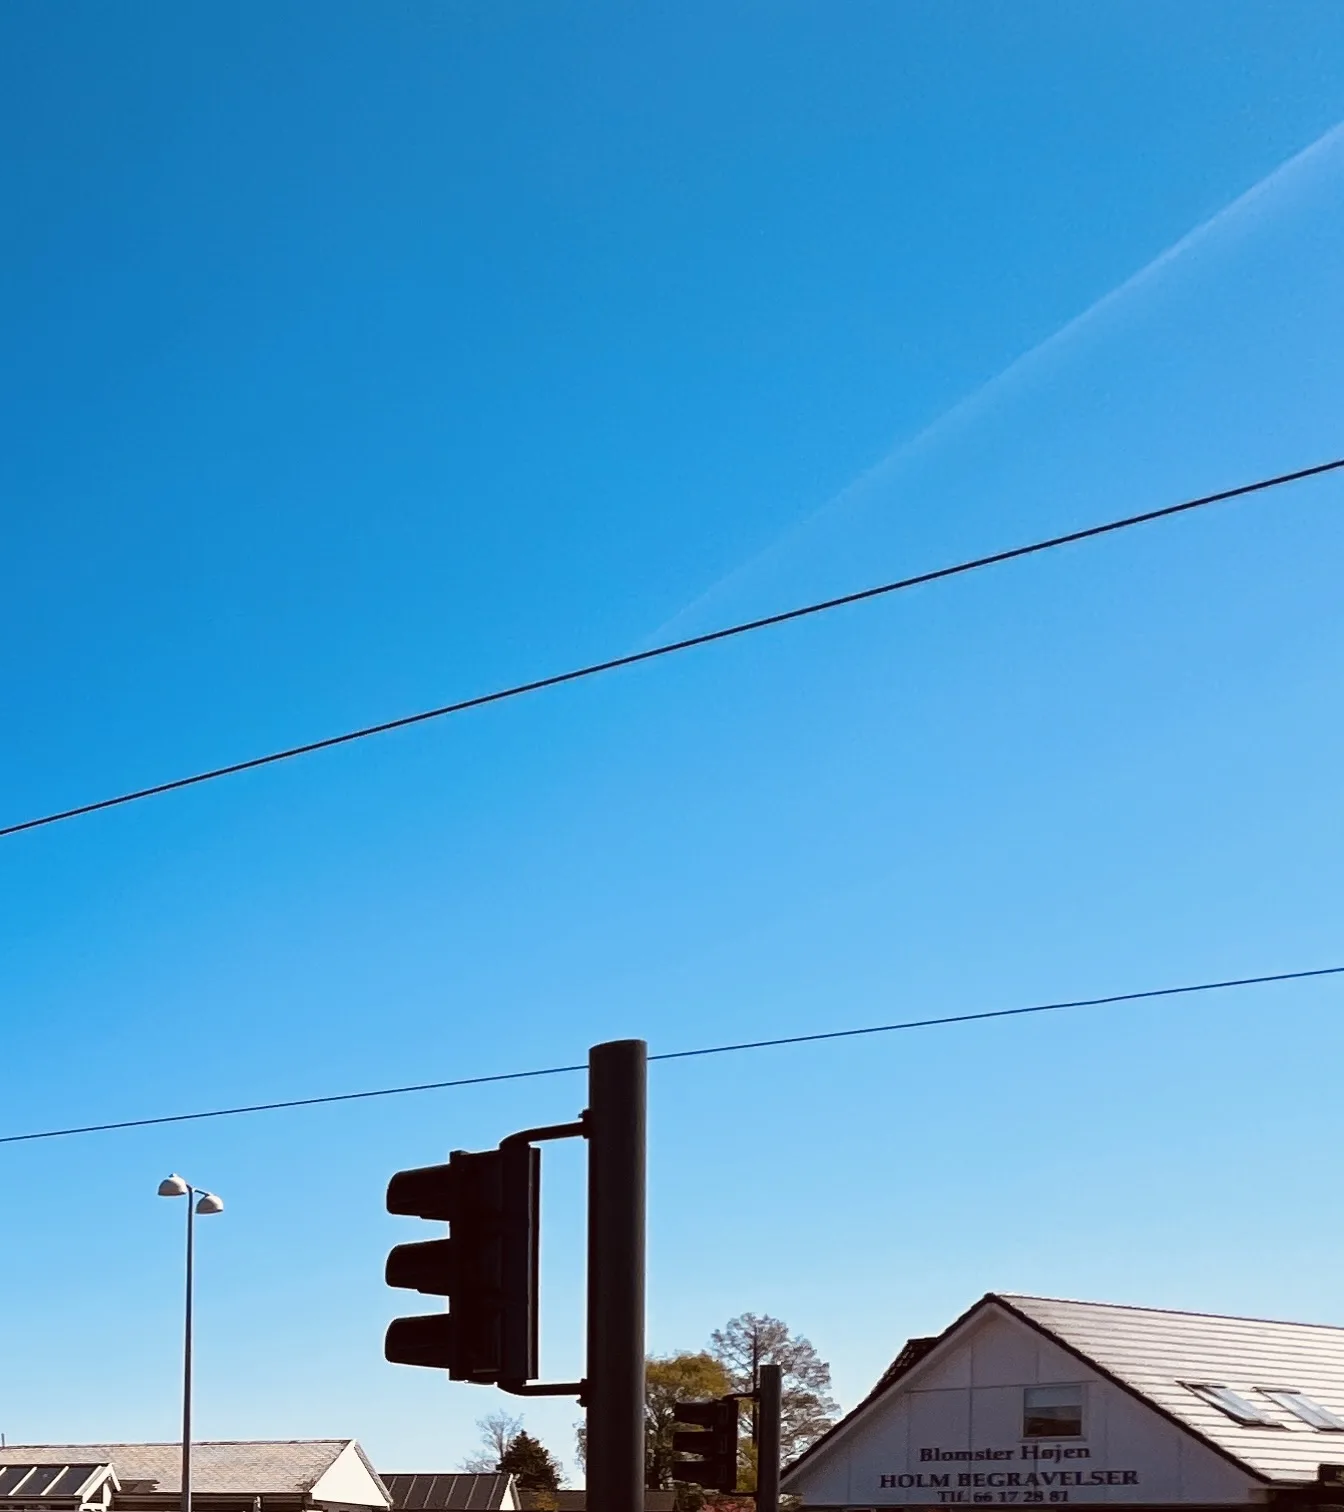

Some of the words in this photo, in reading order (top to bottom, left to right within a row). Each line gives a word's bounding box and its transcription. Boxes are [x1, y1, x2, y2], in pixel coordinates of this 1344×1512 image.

[920, 1447, 1015, 1462] Blomster
[1020, 1444, 1091, 1464] Højen
[879, 1473, 951, 1488] HOLM
[958, 1470, 1140, 1487] BEGRAVELSER
[973, 1491, 993, 1503] 66
[998, 1491, 1018, 1503] 17
[1023, 1490, 1044, 1502] 28
